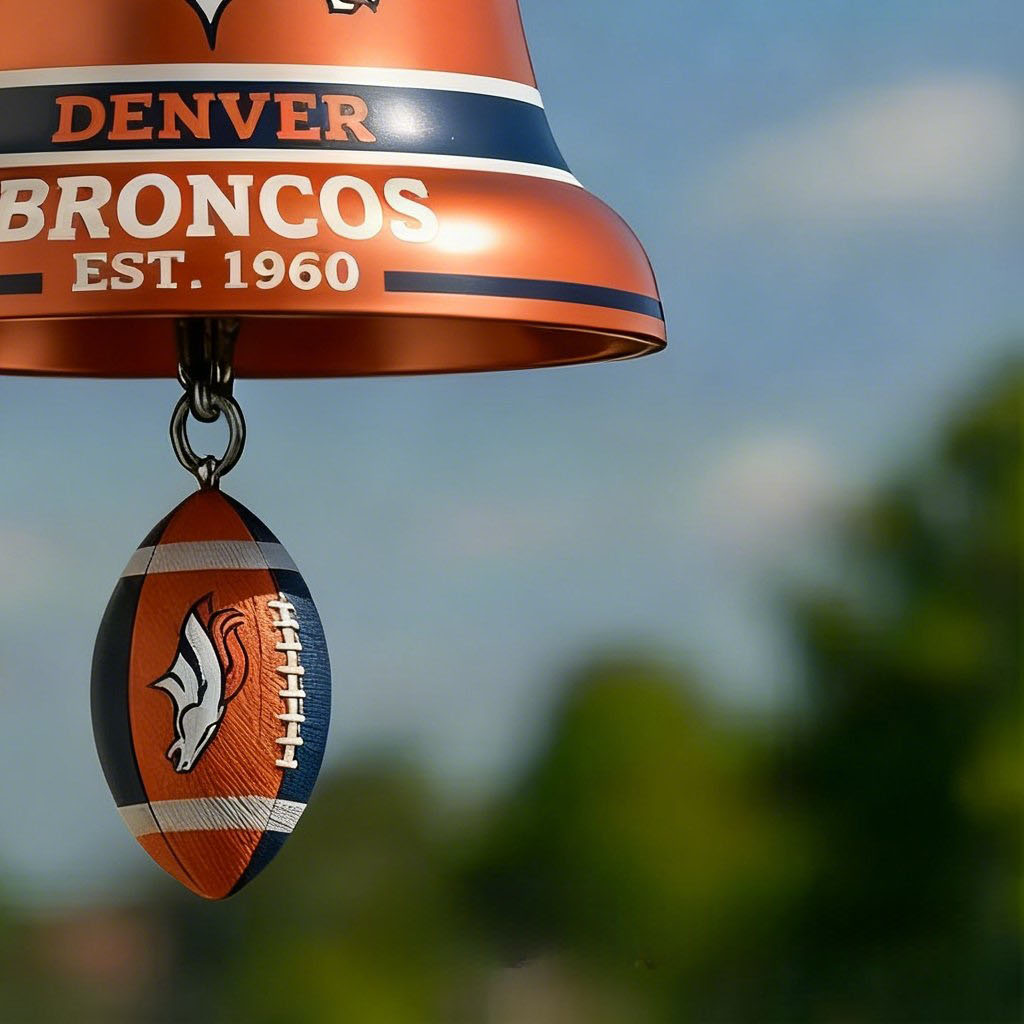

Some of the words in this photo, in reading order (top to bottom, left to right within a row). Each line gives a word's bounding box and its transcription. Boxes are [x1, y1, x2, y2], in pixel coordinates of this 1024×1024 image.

[51, 92, 376, 143] DENVER
[72, 250, 202, 291] EST.
[224, 250, 360, 292] 1960
